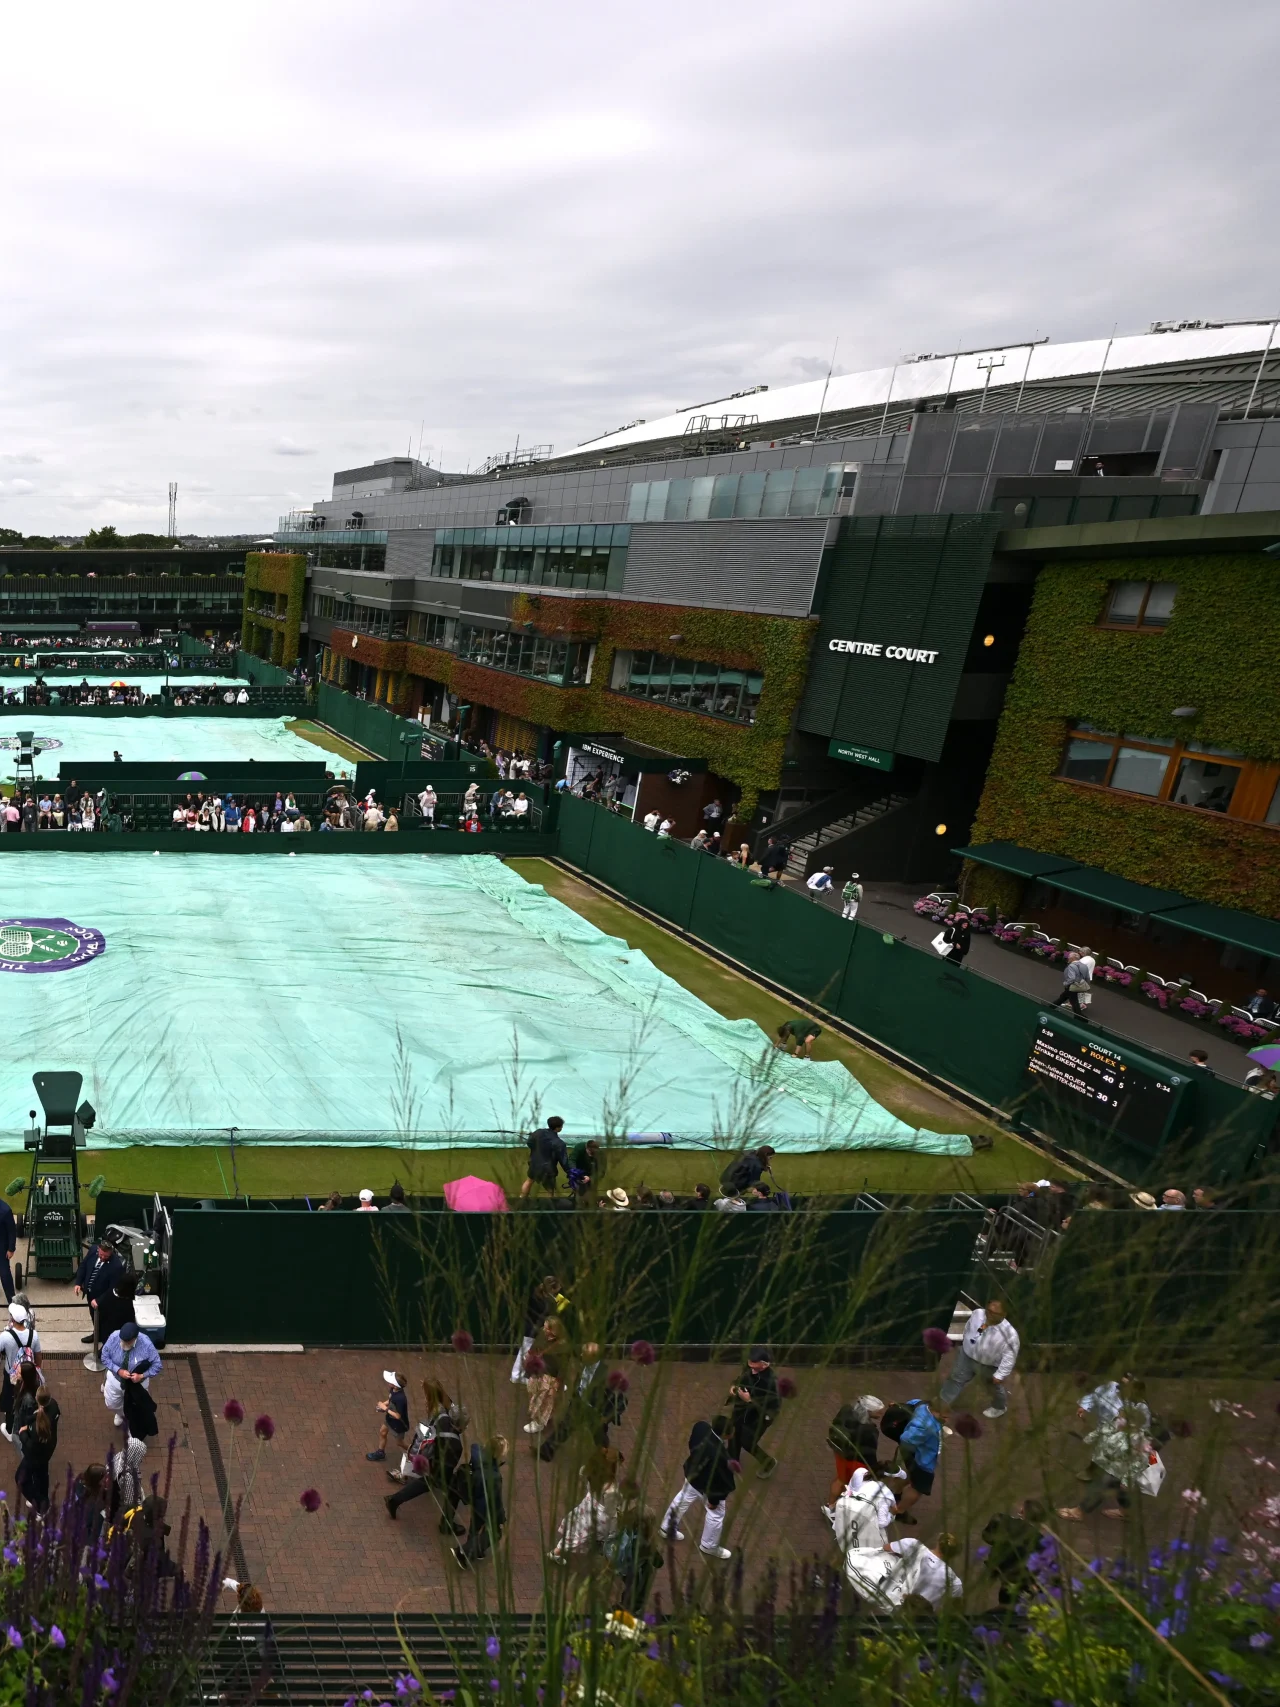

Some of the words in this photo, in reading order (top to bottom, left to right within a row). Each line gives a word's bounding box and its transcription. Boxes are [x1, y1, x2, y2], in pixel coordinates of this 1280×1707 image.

[828, 639, 883, 657] CENTRE
[885, 646, 939, 664] COURT
[582, 744, 592, 753] IBM
[592, 748, 625, 764] EXPERIENCE
[837, 748, 854, 757] NORTH
[854, 752, 868, 760] WEST
[868, 756, 881, 764] HALL
[1034, 1044, 1055, 1058] Ulrikke
[1055, 1055, 1076, 1069] EIKERI
[1036, 1039, 1058, 1054] Maximo
[1058, 1050, 1092, 1070] GONZALEZ
[1088, 1042, 1113, 1057] COURT
[1113, 1053, 1122, 1061] 14
[1090, 1050, 1117, 1068] ROLEX
[1064, 1073, 1086, 1087] ROJER
[1102, 1074, 1115, 1084] 40
[1096, 1092, 1108, 1102] 30
